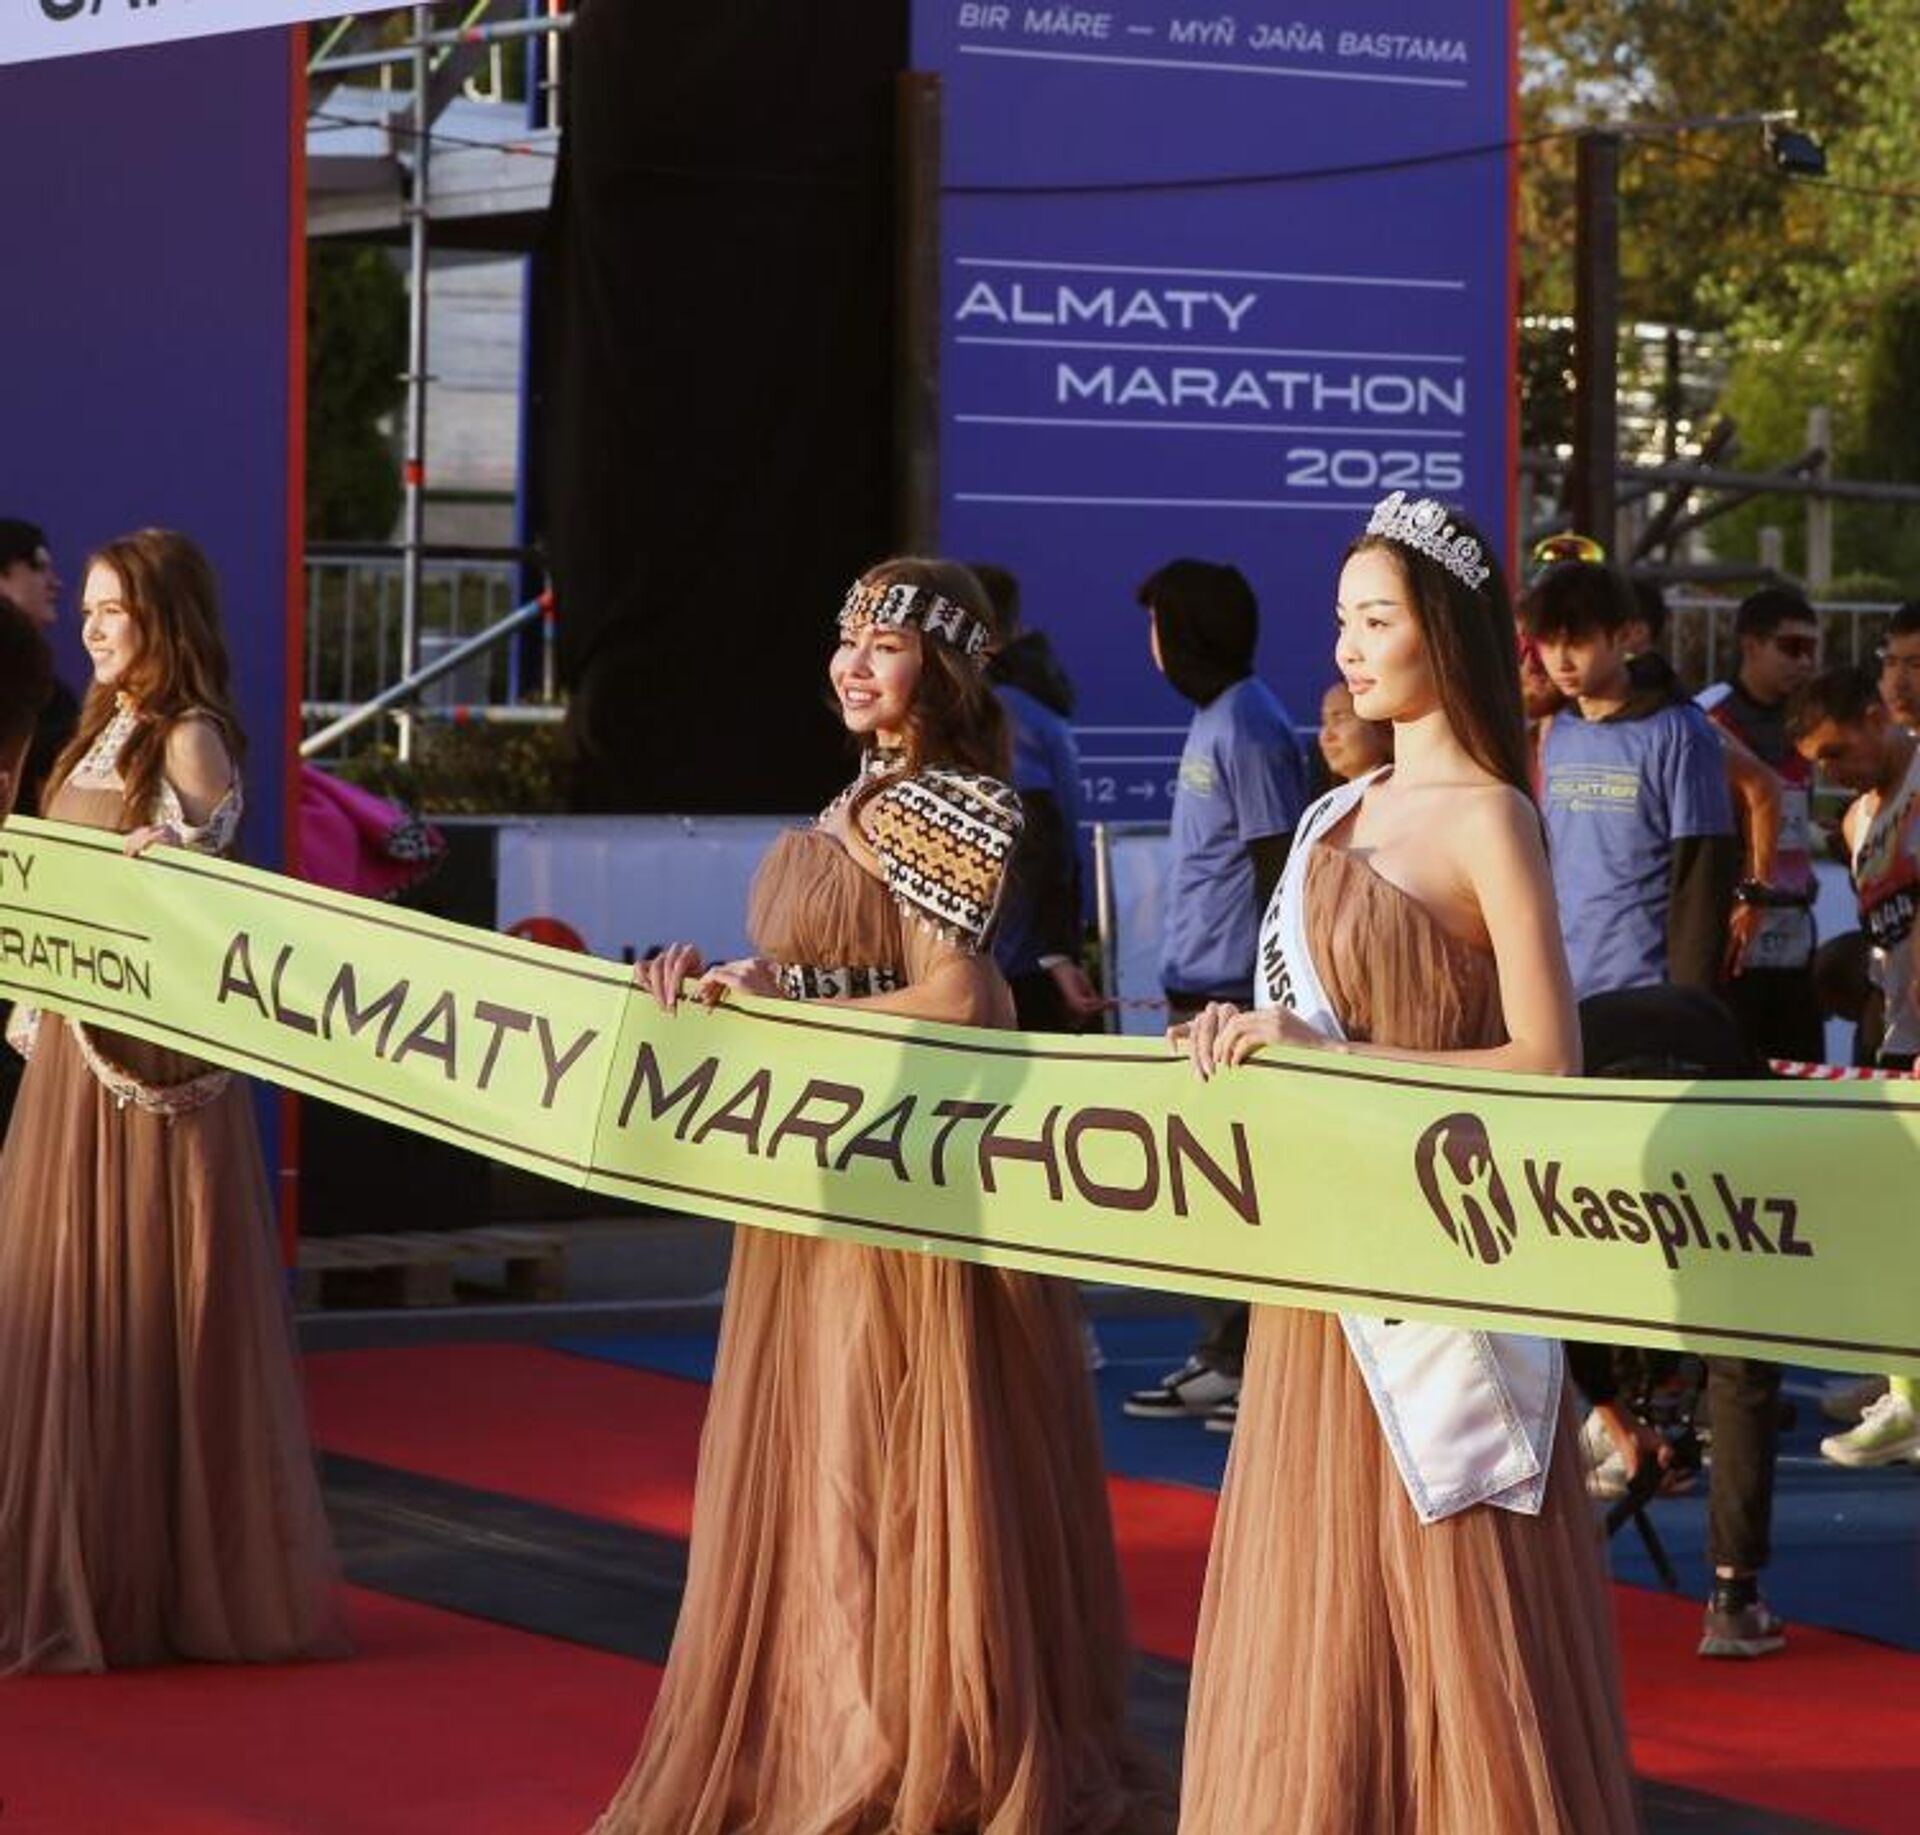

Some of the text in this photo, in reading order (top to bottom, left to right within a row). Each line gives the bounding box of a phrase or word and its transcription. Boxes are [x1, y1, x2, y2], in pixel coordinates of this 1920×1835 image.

[959, 3, 1010, 31] BIR
[1023, 6, 1112, 39] MÄRE
[1337, 30, 1468, 63] BASTAMA
[956, 281, 1257, 332] ALMATY
[1057, 363, 1465, 415] MARATHON
[1286, 448, 1464, 490] 2025
[217, 932, 1261, 1226] ALMATY MARATHON
[1523, 1158, 1815, 1270] Kaspi.kz
